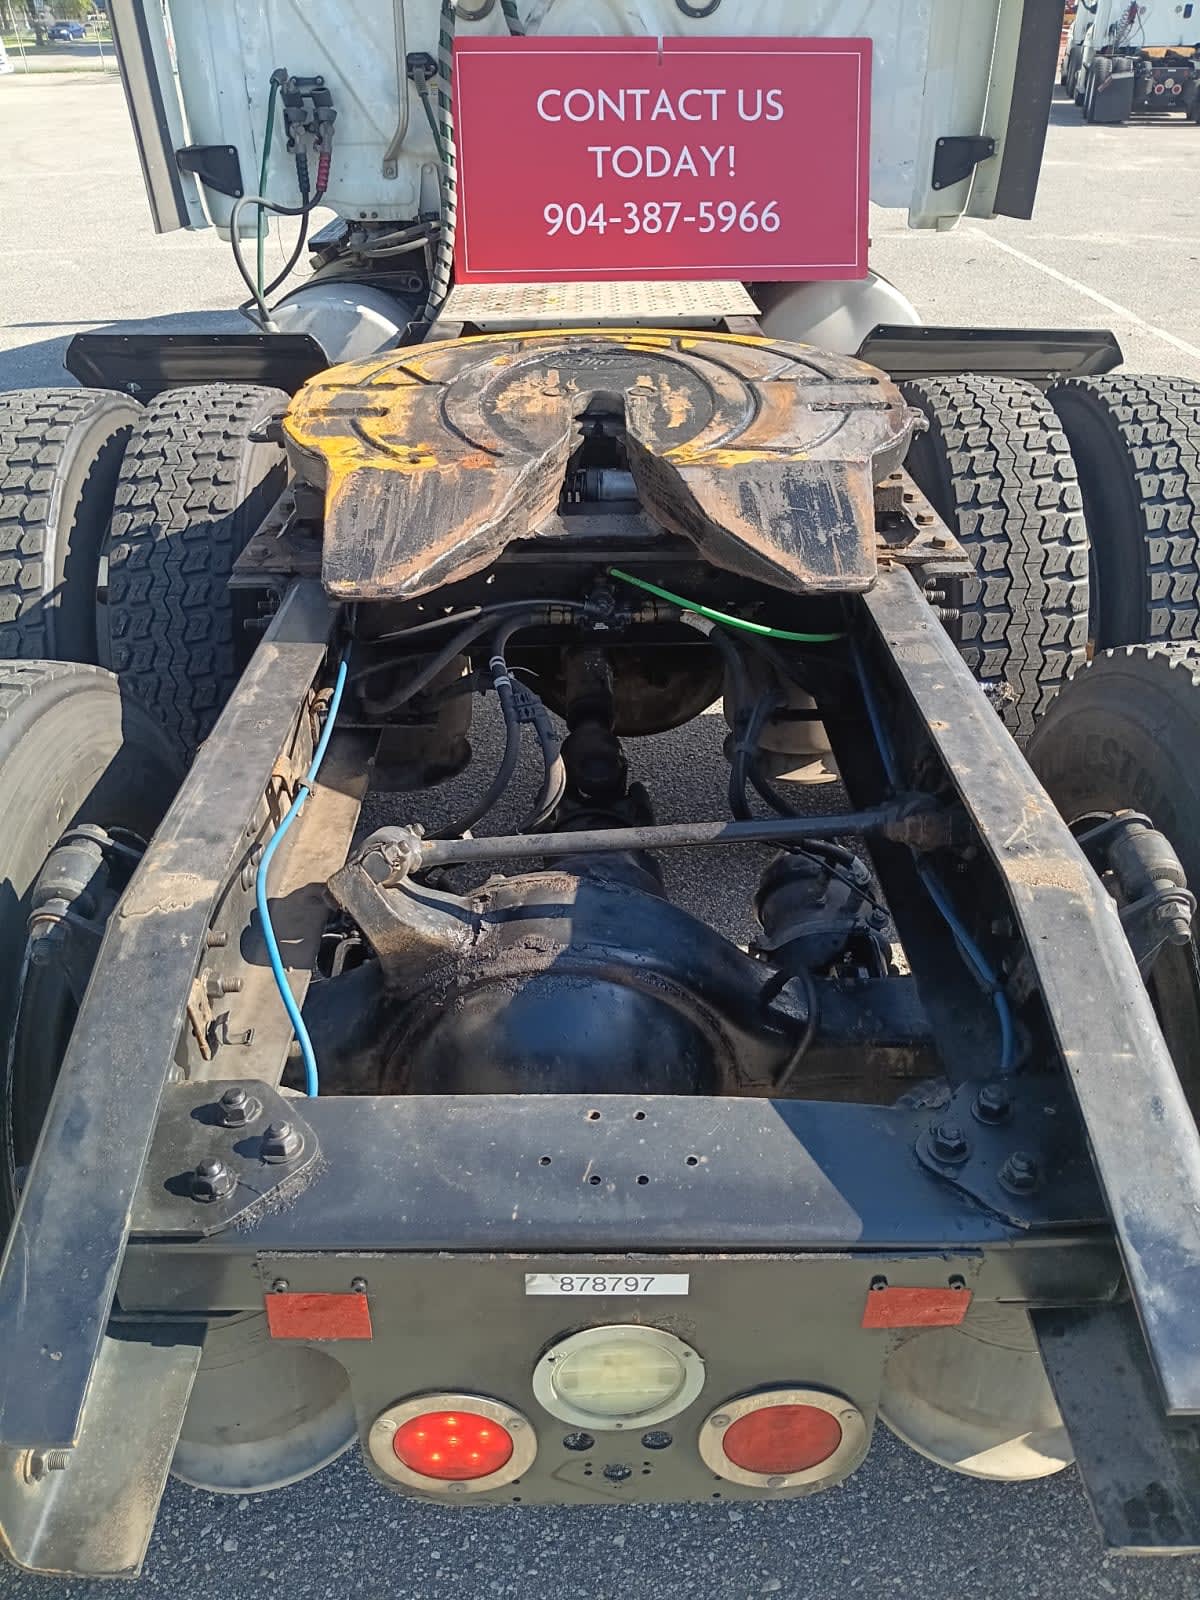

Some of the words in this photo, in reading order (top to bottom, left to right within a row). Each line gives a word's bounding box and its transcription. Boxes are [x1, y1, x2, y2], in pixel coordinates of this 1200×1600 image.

[536, 88, 726, 122] CONTACT
[738, 88, 784, 121] US
[587, 145, 735, 178] TODAY!
[543, 200, 781, 236] 904-387-5966
[559, 1276, 656, 1292] 878797
